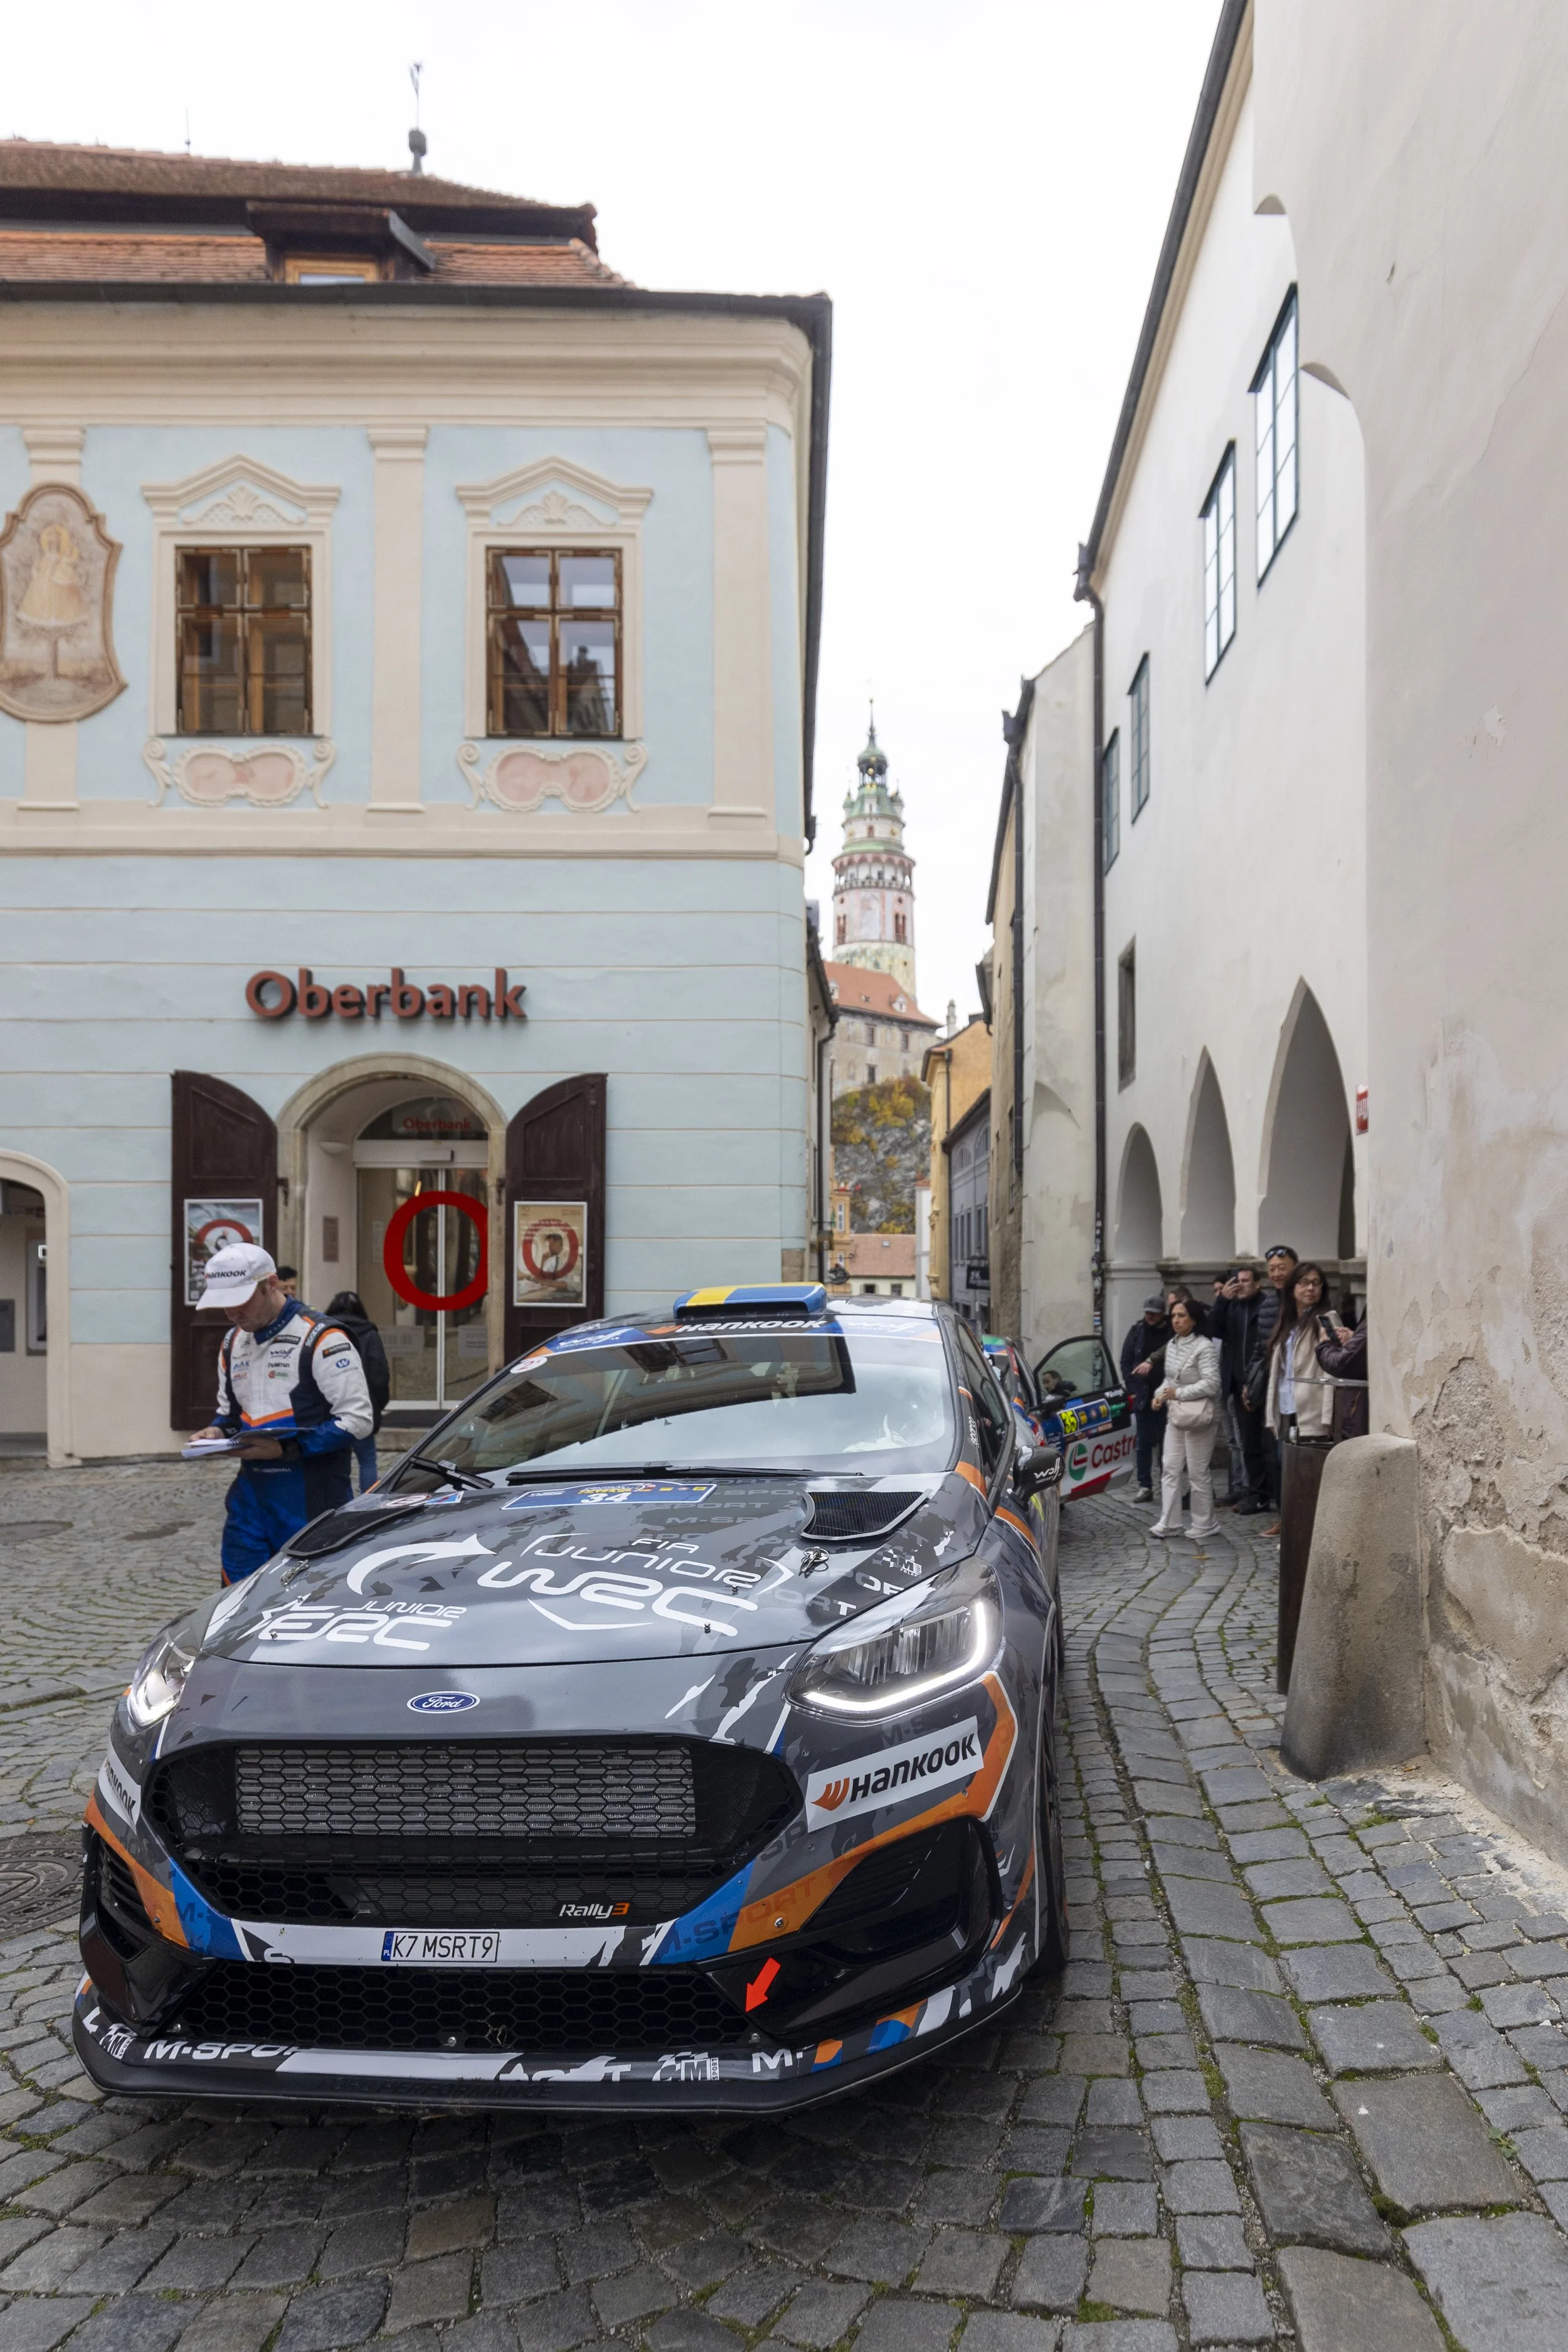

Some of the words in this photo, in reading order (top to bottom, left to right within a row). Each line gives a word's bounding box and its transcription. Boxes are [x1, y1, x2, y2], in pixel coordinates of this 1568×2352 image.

[245, 967, 527, 1018] Oberbank
[403, 1116, 472, 1130] Oberbank
[1060, 1409, 1078, 1434] 35
[580, 1492, 632, 1503] 34
[631, 1538, 700, 1554] FIA
[534, 1545, 762, 1589] JUNIOR
[342, 1600, 467, 1619] JUNIOR
[422, 1696, 462, 1709] Ford
[559, 1902, 630, 1919] Rally3
[393, 1935, 419, 1958] K7
[422, 1935, 494, 1959] MSRT9
[711, 2058, 719, 2080] SPORT
